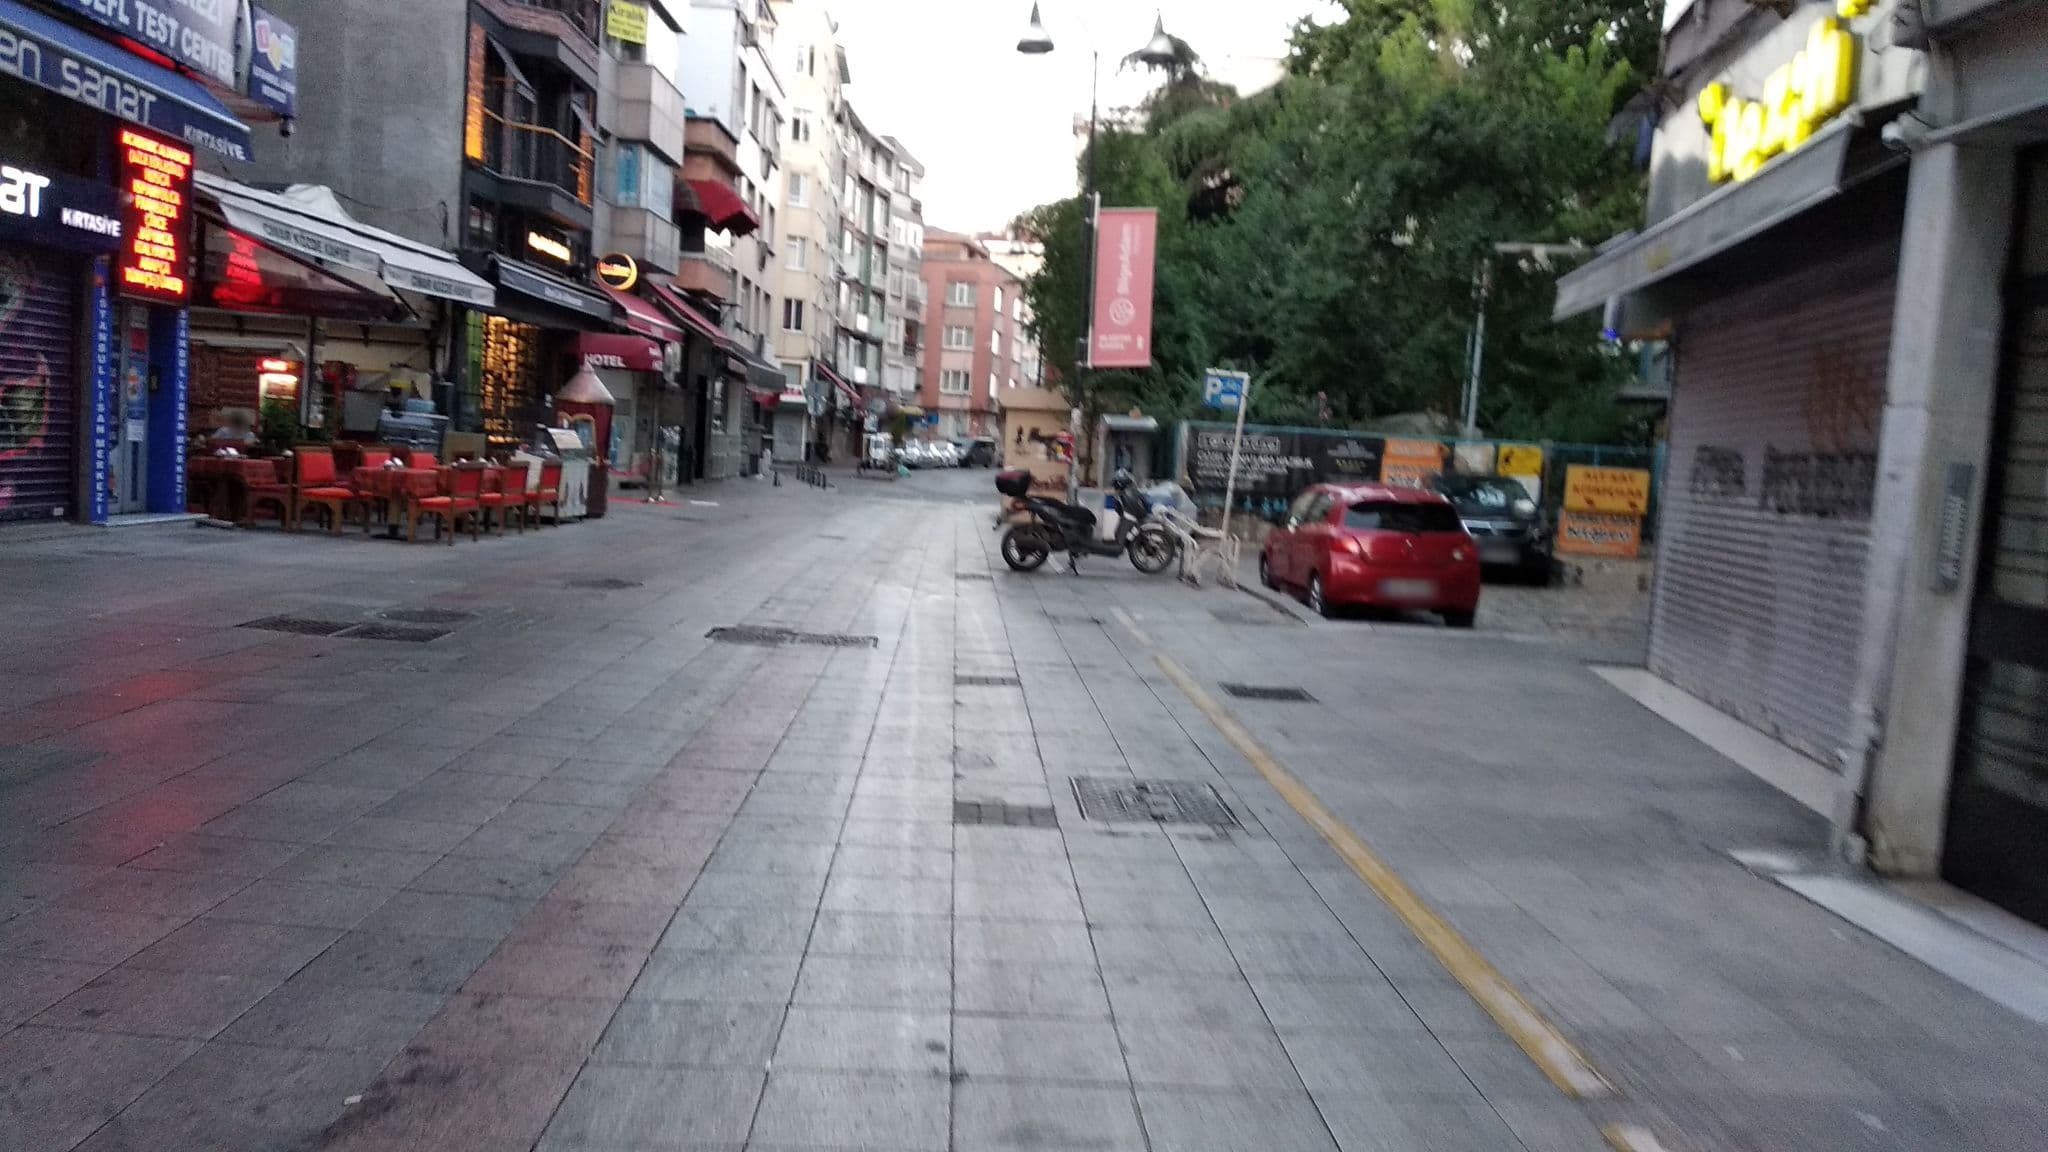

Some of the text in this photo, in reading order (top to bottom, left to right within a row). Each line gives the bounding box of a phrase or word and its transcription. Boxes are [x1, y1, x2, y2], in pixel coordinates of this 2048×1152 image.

[134, 0, 179, 48] TEST
[182, 26, 235, 89] CENTER
[584, 352, 627, 368] HOTEL
[1205, 376, 1223, 403] P
